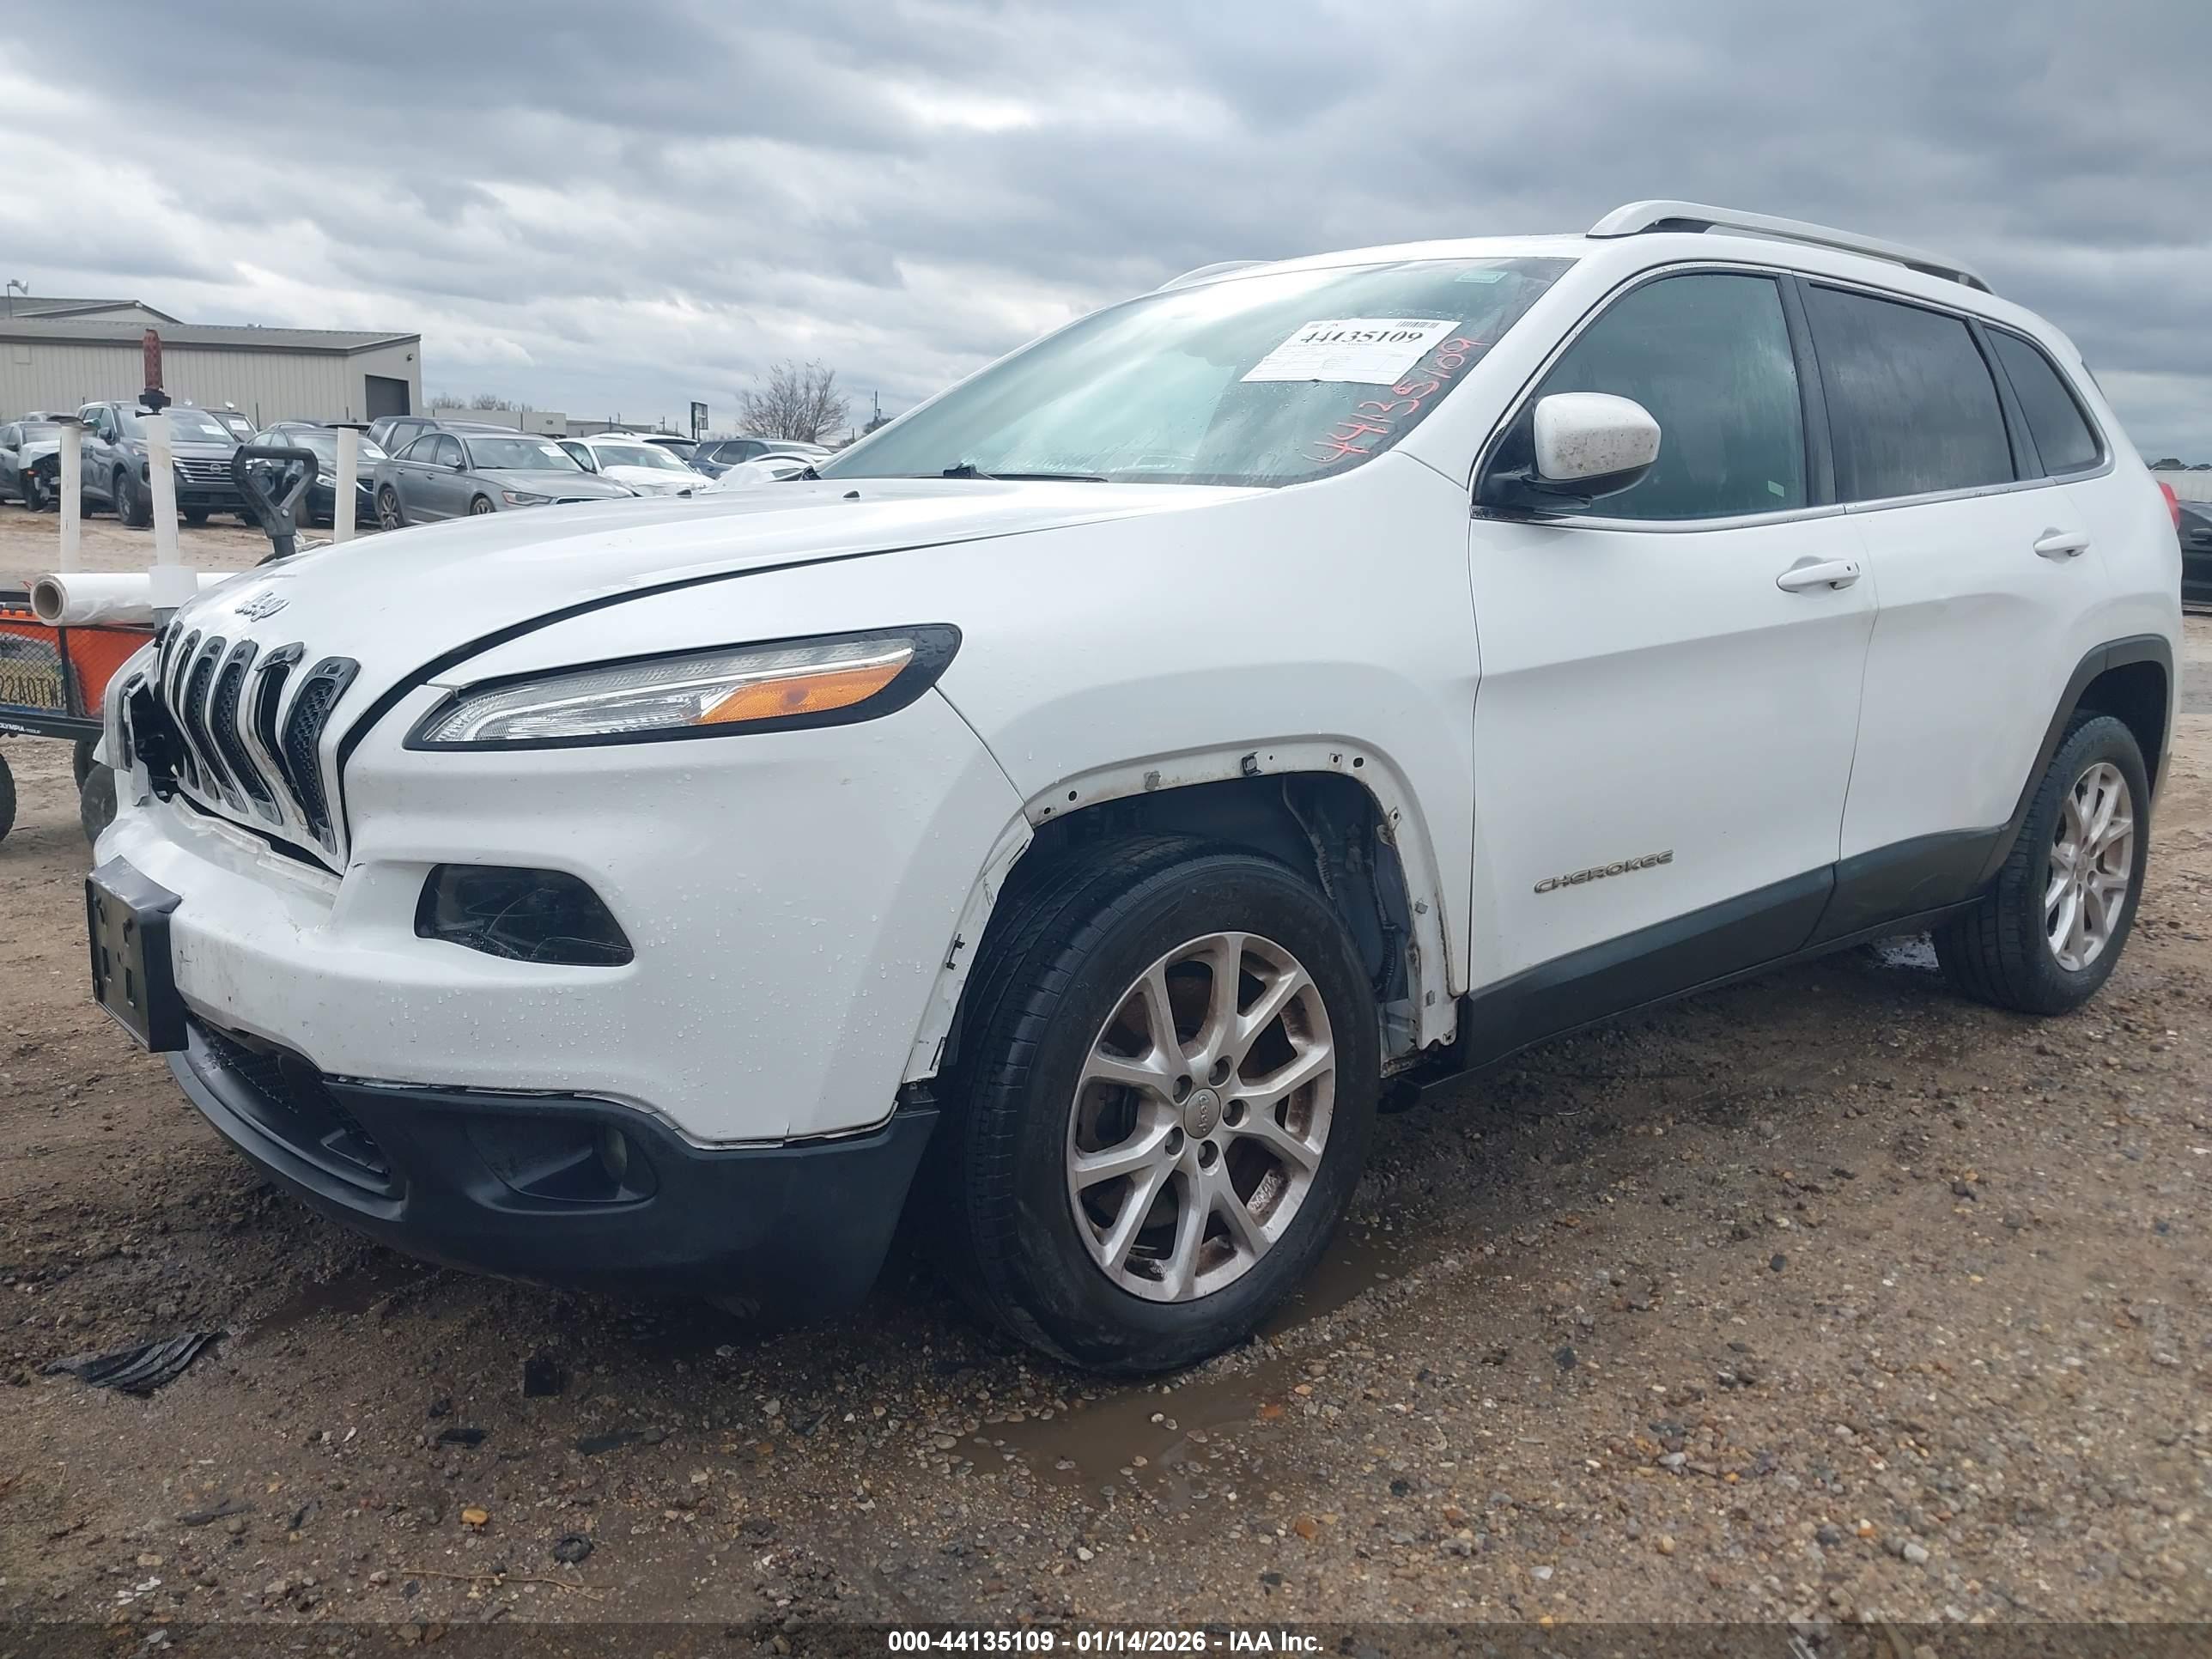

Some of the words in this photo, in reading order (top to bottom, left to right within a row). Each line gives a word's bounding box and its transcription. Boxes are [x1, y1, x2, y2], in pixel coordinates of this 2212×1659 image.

[1300, 330, 1424, 343] 44135109
[1301, 337, 1492, 463] 44135109
[234, 591, 290, 623] Jeep
[1534, 849, 1674, 894] CHEROKEE
[1198, 1094, 1210, 1132] Jeep
